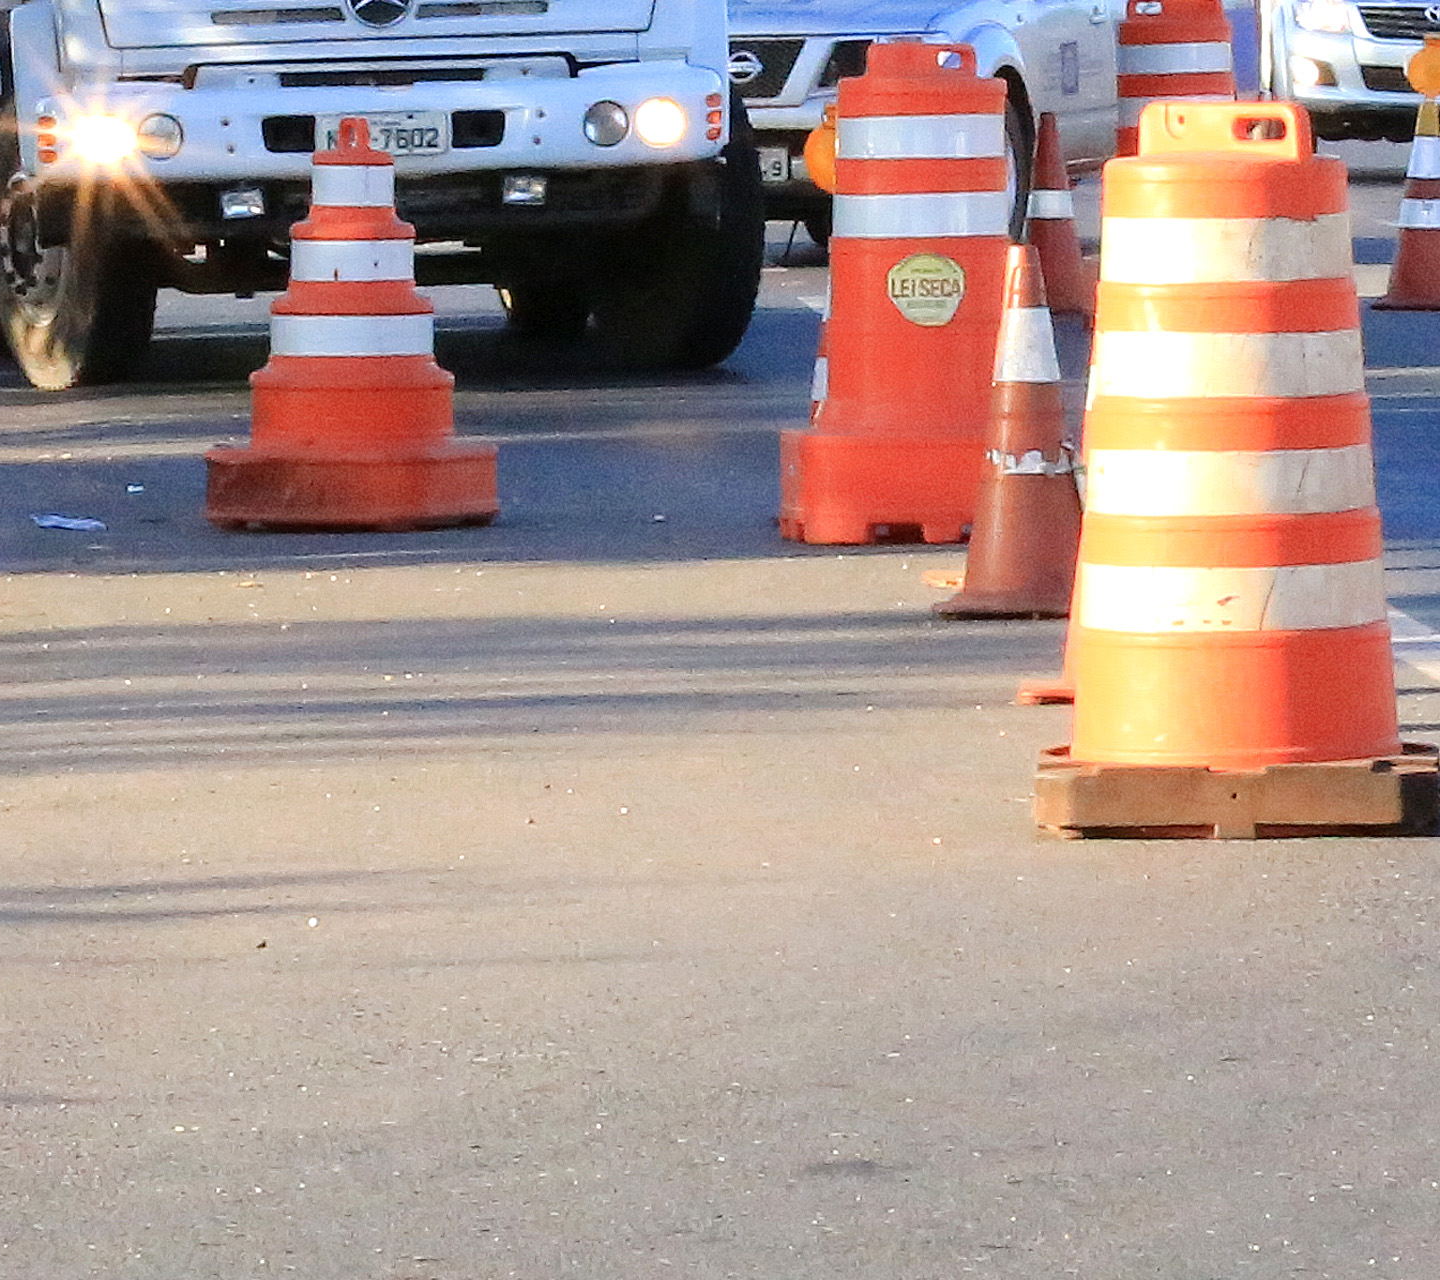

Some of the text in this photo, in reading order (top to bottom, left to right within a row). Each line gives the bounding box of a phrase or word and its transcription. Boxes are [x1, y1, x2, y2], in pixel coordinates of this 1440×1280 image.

[326, 127, 439, 150] K-7602
[891, 277, 961, 298] LEI SECA
